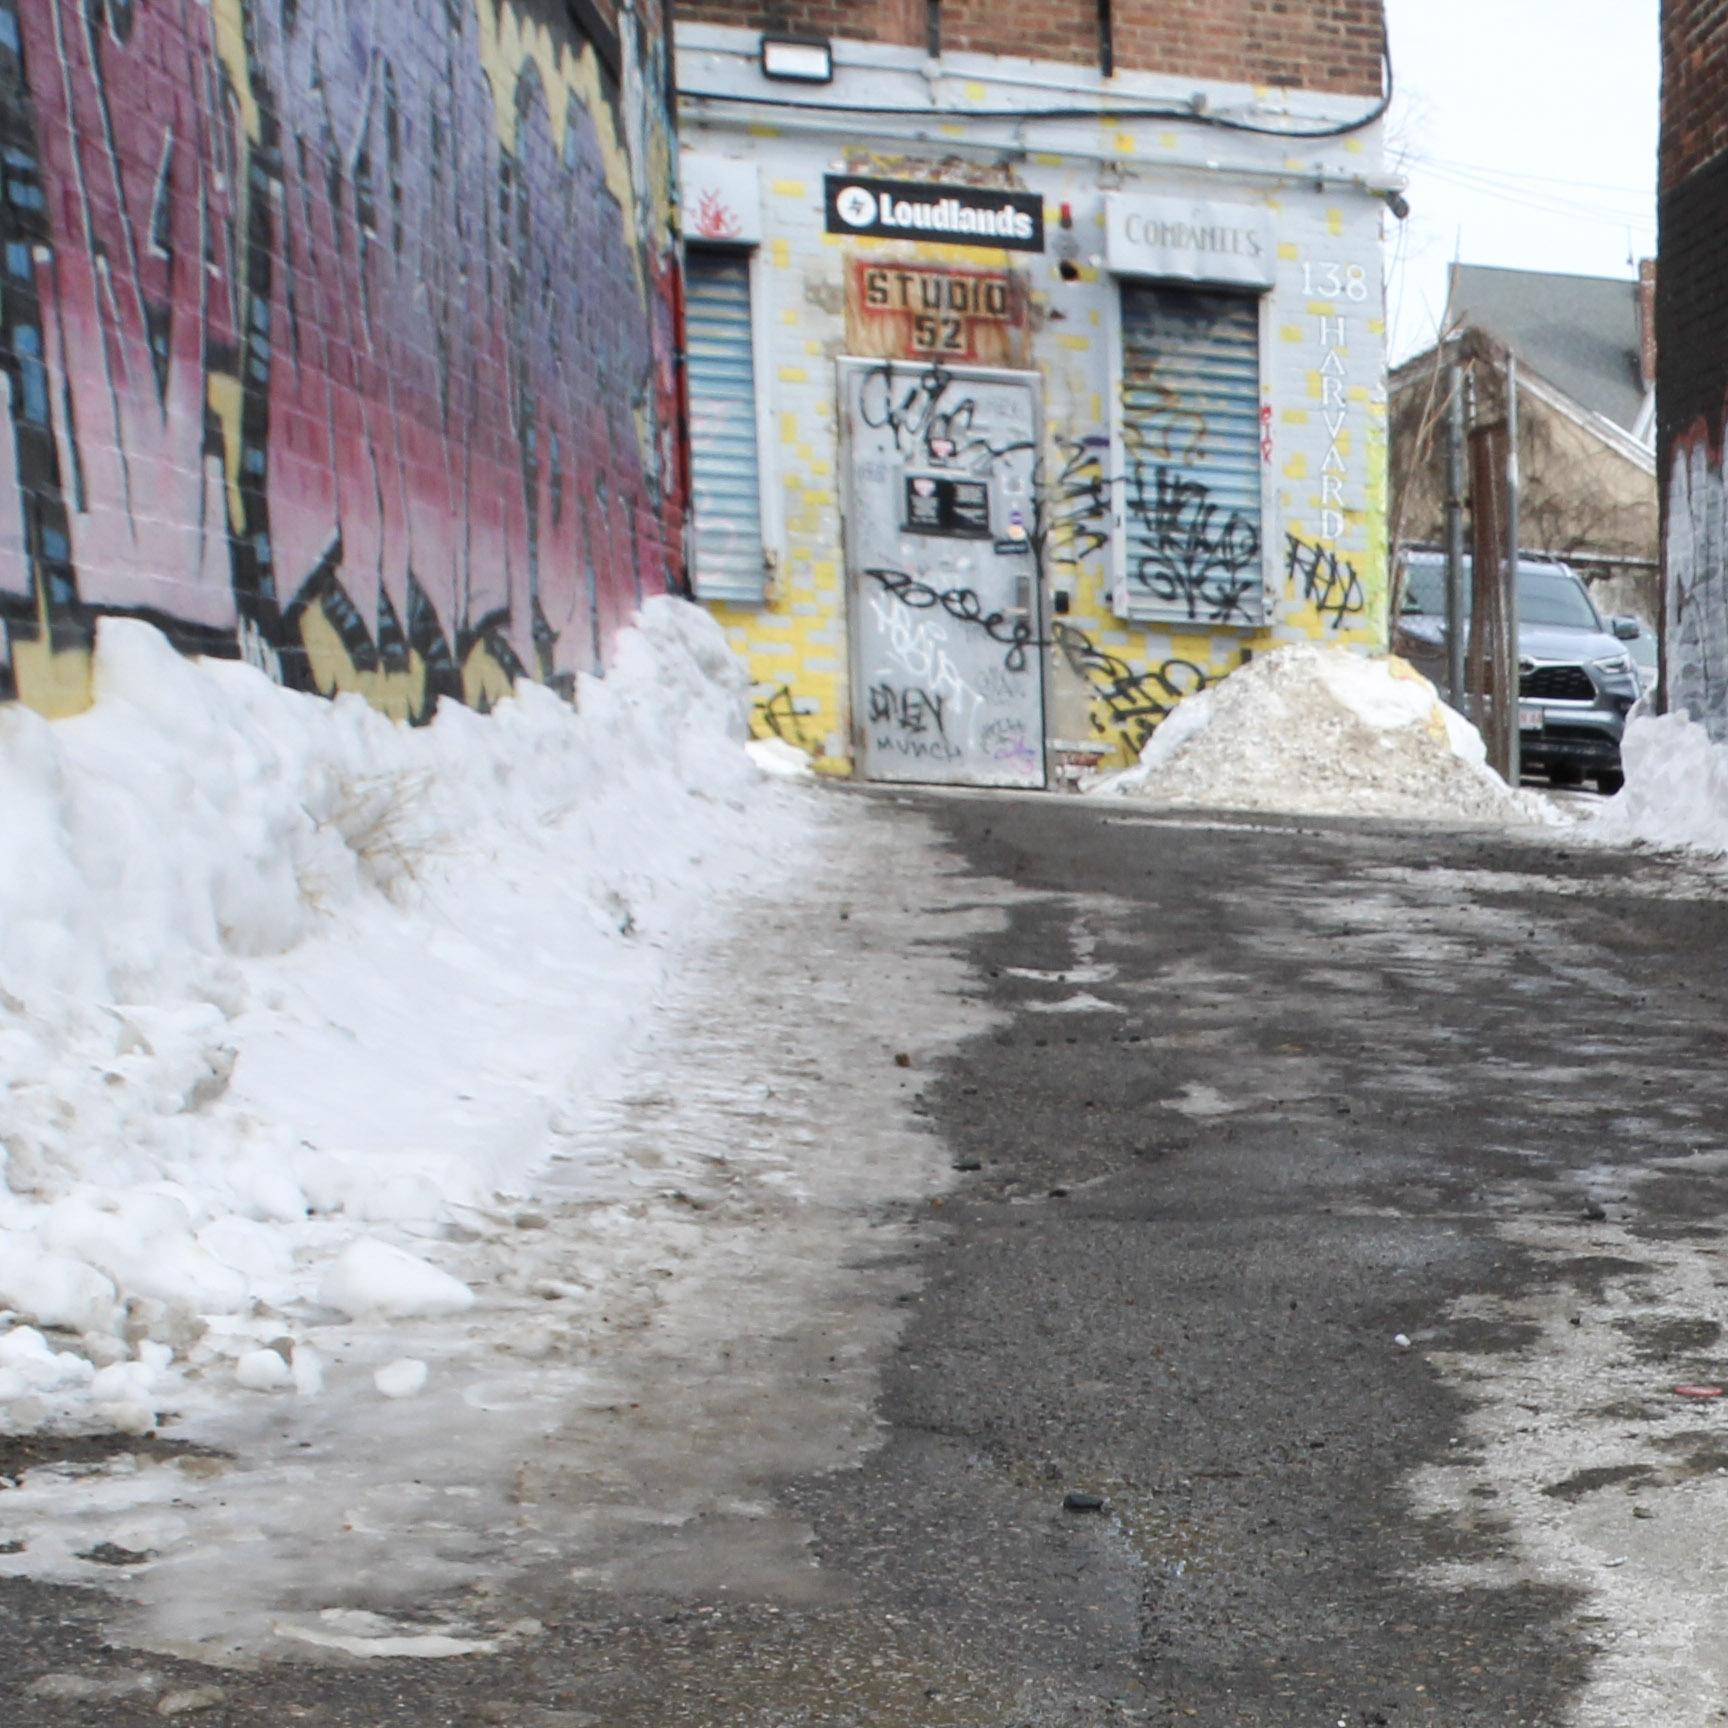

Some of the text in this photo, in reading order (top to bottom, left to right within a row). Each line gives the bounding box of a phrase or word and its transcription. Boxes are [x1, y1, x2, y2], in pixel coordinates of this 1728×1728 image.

[879, 192, 1034, 240] Loudlands
[866, 270, 1007, 315] STUDIO
[1301, 260, 1368, 301] 138
[914, 313, 963, 349] 52
[1319, 315, 1346, 540] HARVARD
